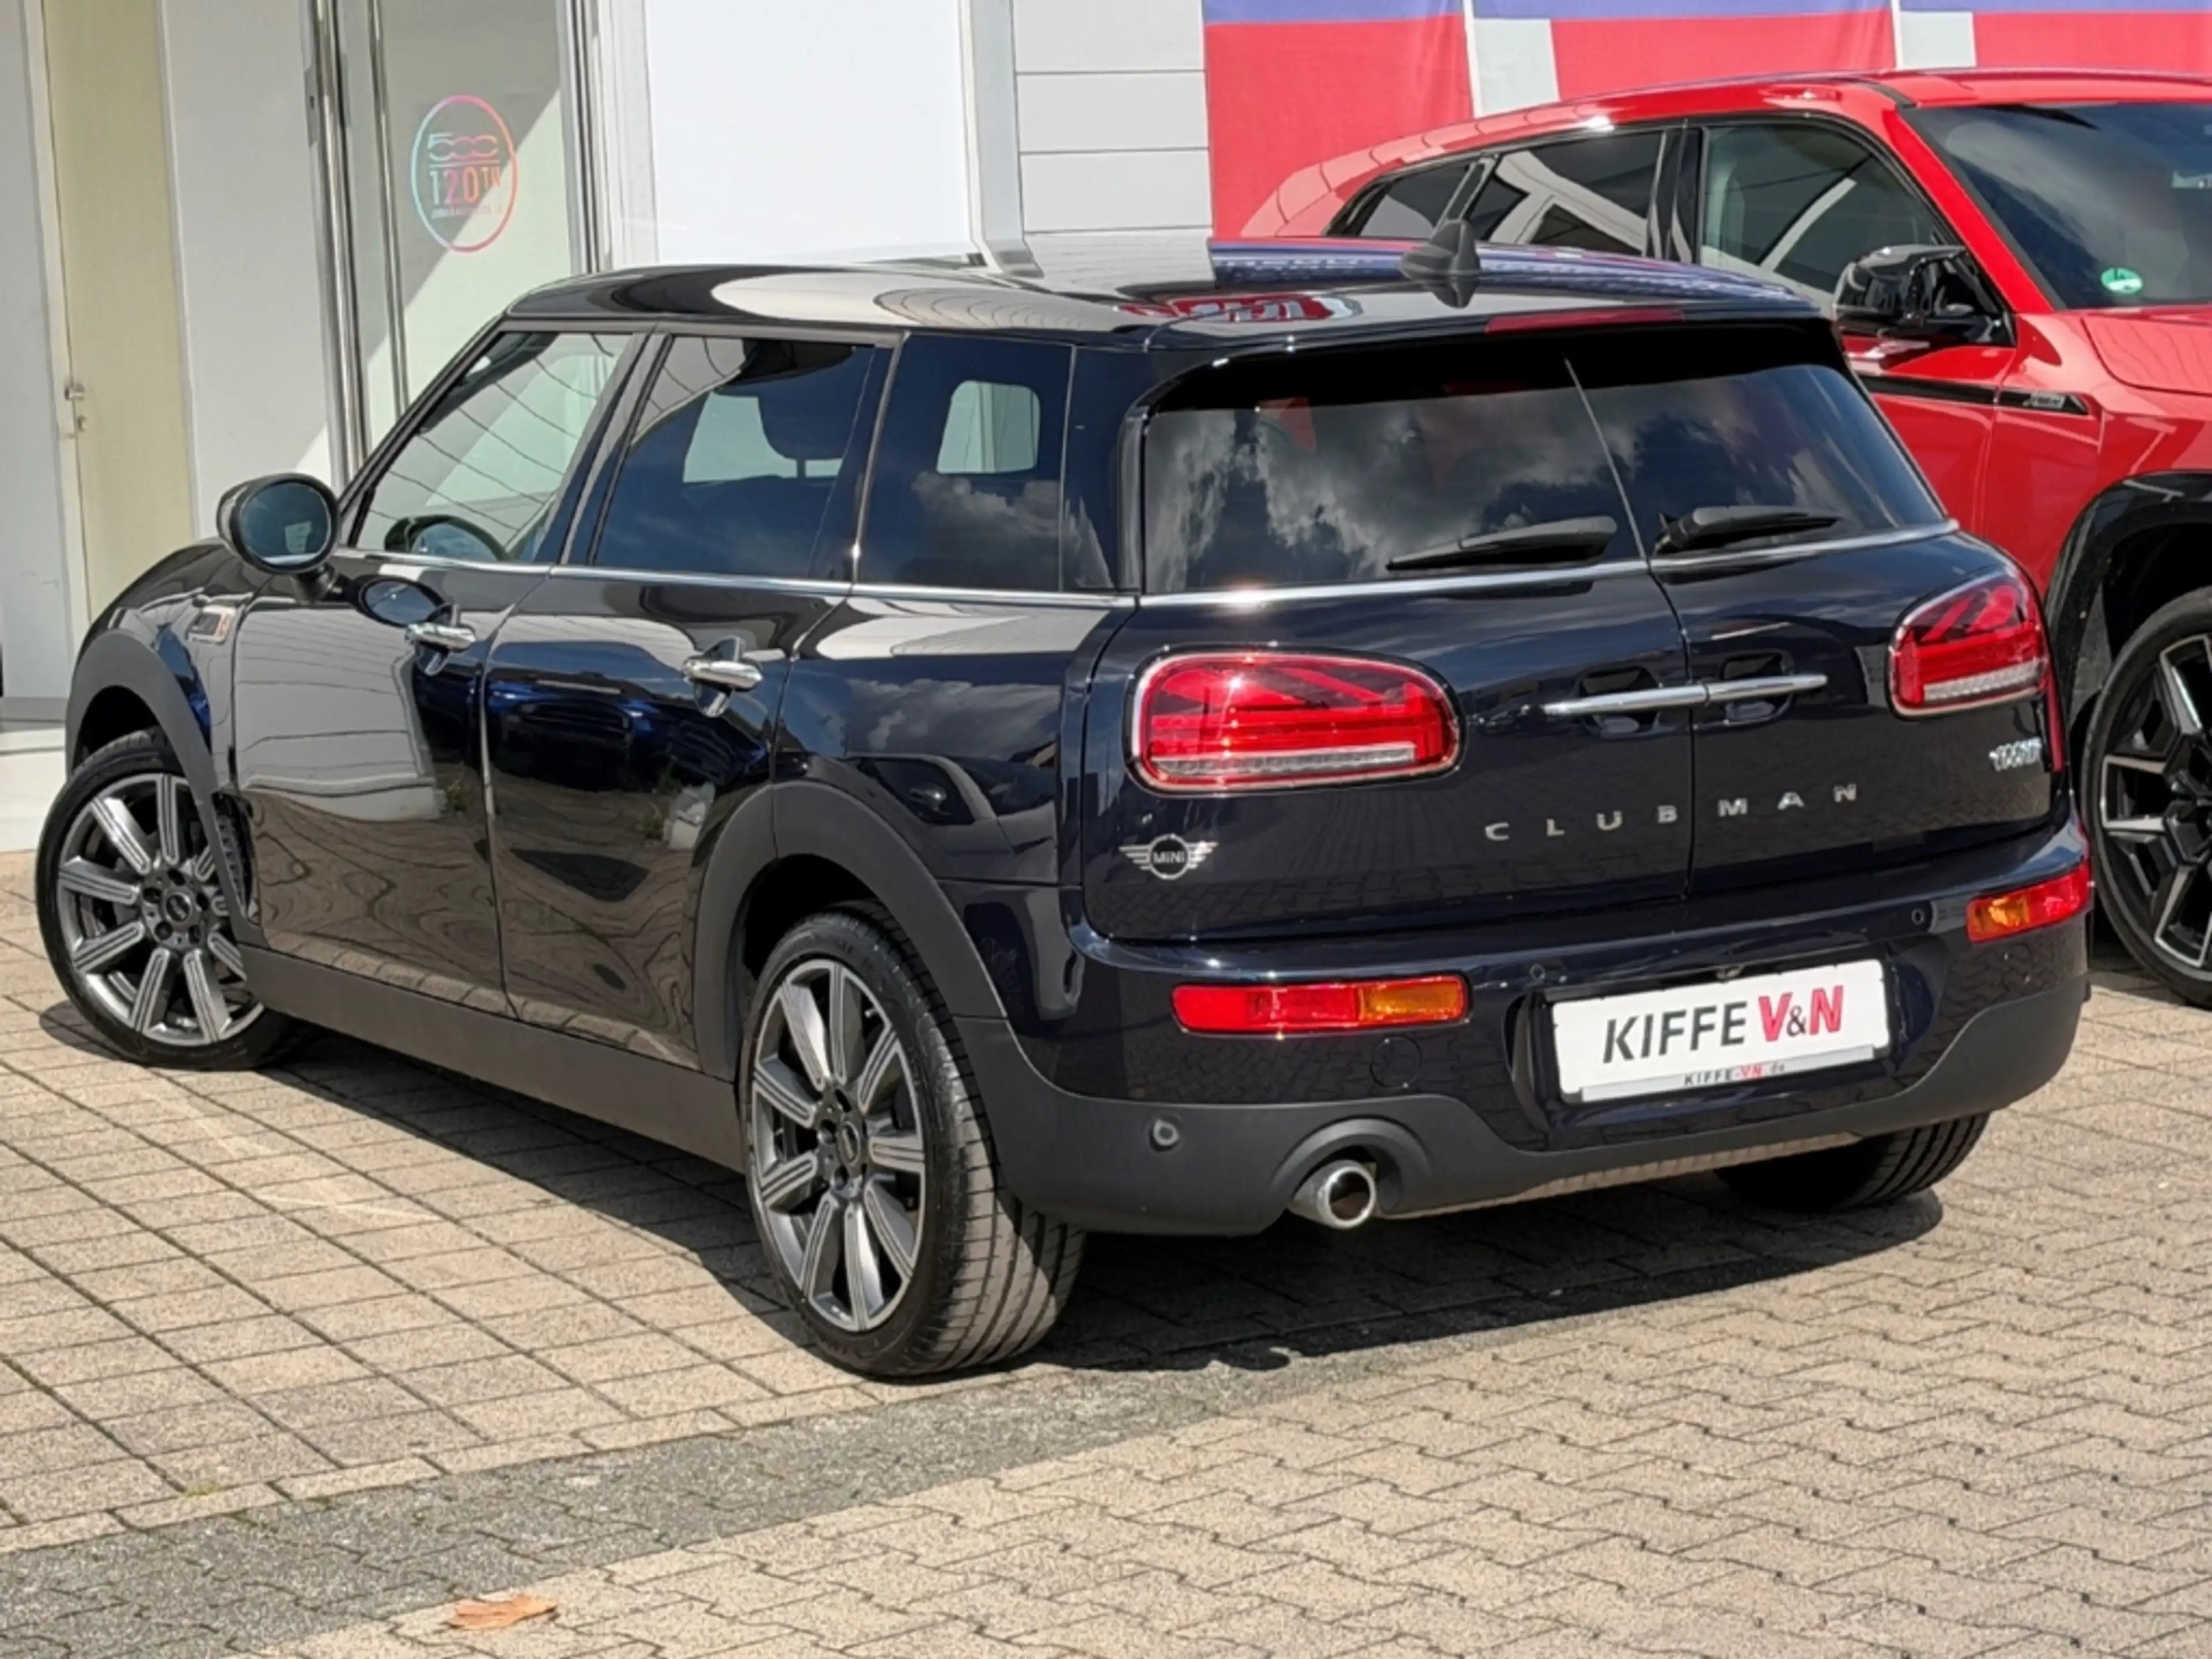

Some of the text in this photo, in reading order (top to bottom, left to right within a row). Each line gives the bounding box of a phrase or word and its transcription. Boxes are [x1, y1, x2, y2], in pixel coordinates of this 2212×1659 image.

[427, 131, 499, 161] 500
[1485, 784, 1857, 841] CLUBMAN
[1153, 850, 1185, 864] MINI
[1602, 985, 1844, 1064] KIFFE V&N
